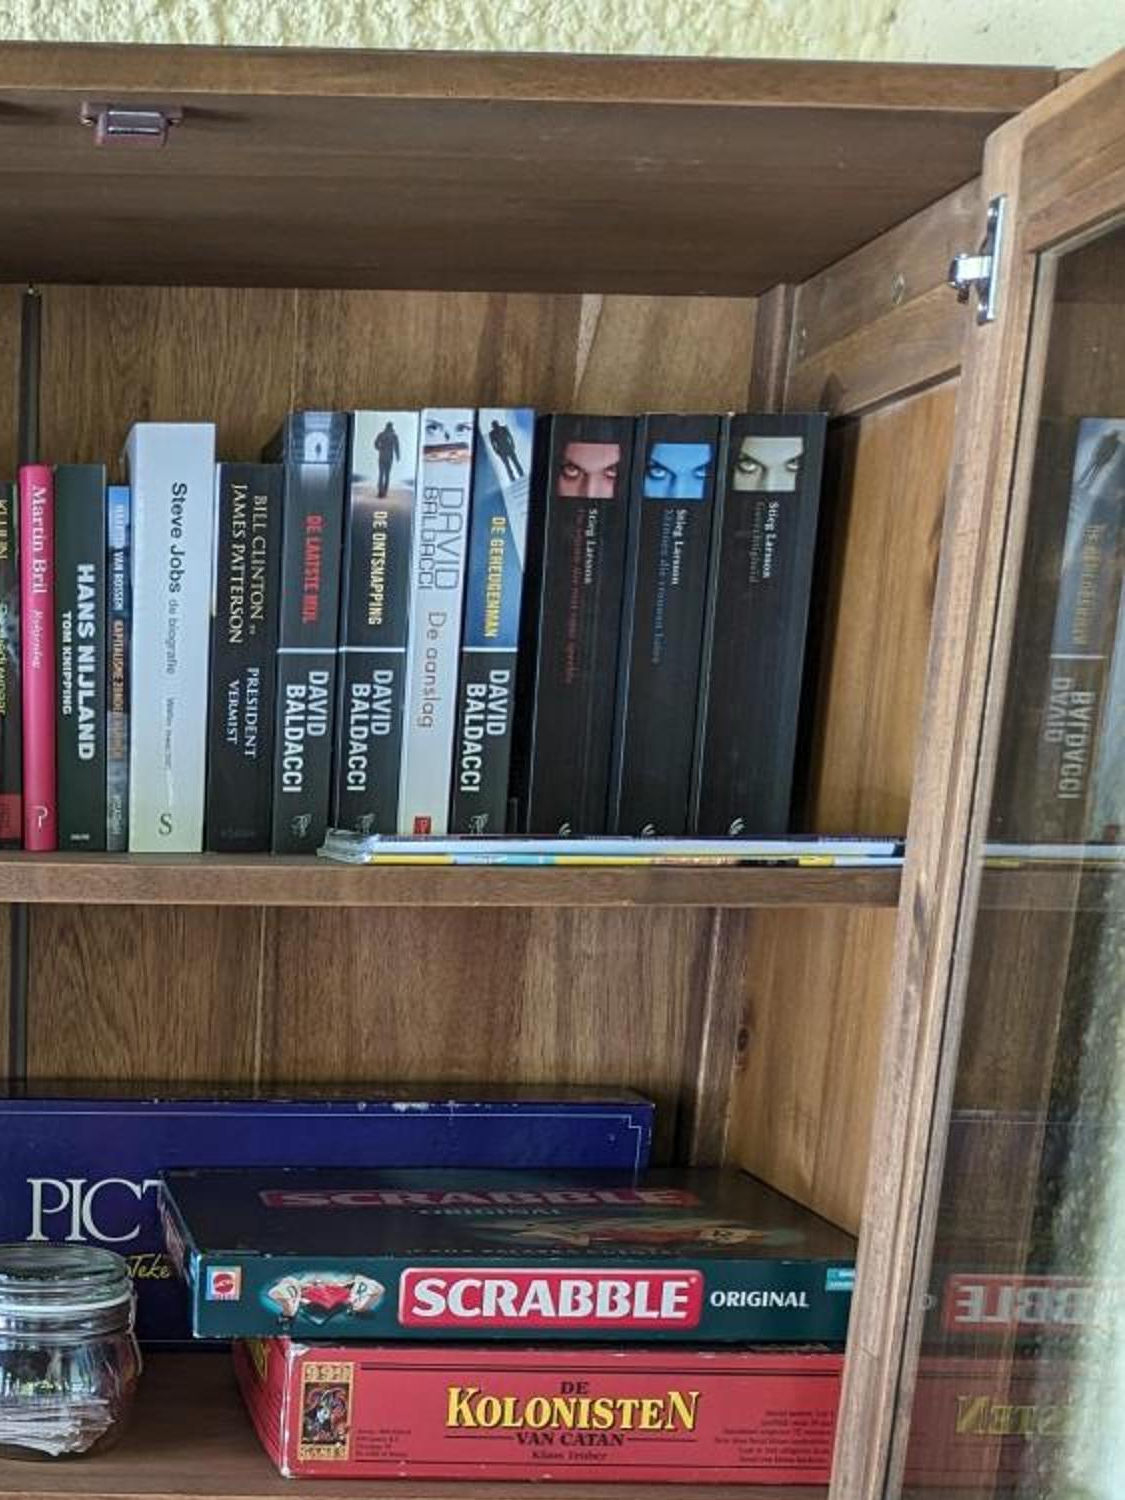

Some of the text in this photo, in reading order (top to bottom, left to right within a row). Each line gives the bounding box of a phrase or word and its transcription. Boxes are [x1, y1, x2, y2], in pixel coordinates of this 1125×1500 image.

[30, 486, 48, 553] Martin
[168, 481, 188, 539] Steve
[416, 487, 439, 591] BALDACCI
[432, 486, 466, 592] DAVID
[761, 501, 780, 580] Stieg Larsson
[31, 559, 49, 594] Bril
[112, 551, 125, 572] VAN
[167, 544, 187, 595] Jobs
[228, 483, 248, 645] JAMES PATTERSON
[249, 494, 268, 621] BILL CLINTON
[303, 513, 323, 593] DE LAATSTE
[366, 511, 388, 627] DE ONTSNAPPING
[482, 517, 505, 638] DE GEHEUGENMAN
[583, 508, 599, 585] Stieg Larsson
[671, 541, 685, 585] Larsson
[167, 598, 182, 617] de
[61, 610, 73, 716] TOM KNIPPING
[76, 563, 96, 761] HANS NIJLAND
[164, 619, 182, 678] biografie
[416, 610, 448, 731] De aanslag
[226, 680, 241, 746] VERMIST
[243, 666, 261, 761] PRESIDENT
[306, 669, 330, 739] DAVID
[368, 669, 395, 736] DAVID
[484, 669, 511, 736] DAVID
[281, 683, 308, 794] BALDACCI
[345, 683, 373, 793] BALDACCI
[459, 683, 487, 793] BALDACCI
[277, 1190, 680, 1208] SCRABBLE
[407, 1278, 683, 1322] SCRABBLE
[710, 1290, 812, 1310] ORIGINAL
[444, 1386, 699, 1433] KOLONISTEN
[558, 1380, 589, 1396] DE
[515, 1430, 625, 1448] VAN CATAN
